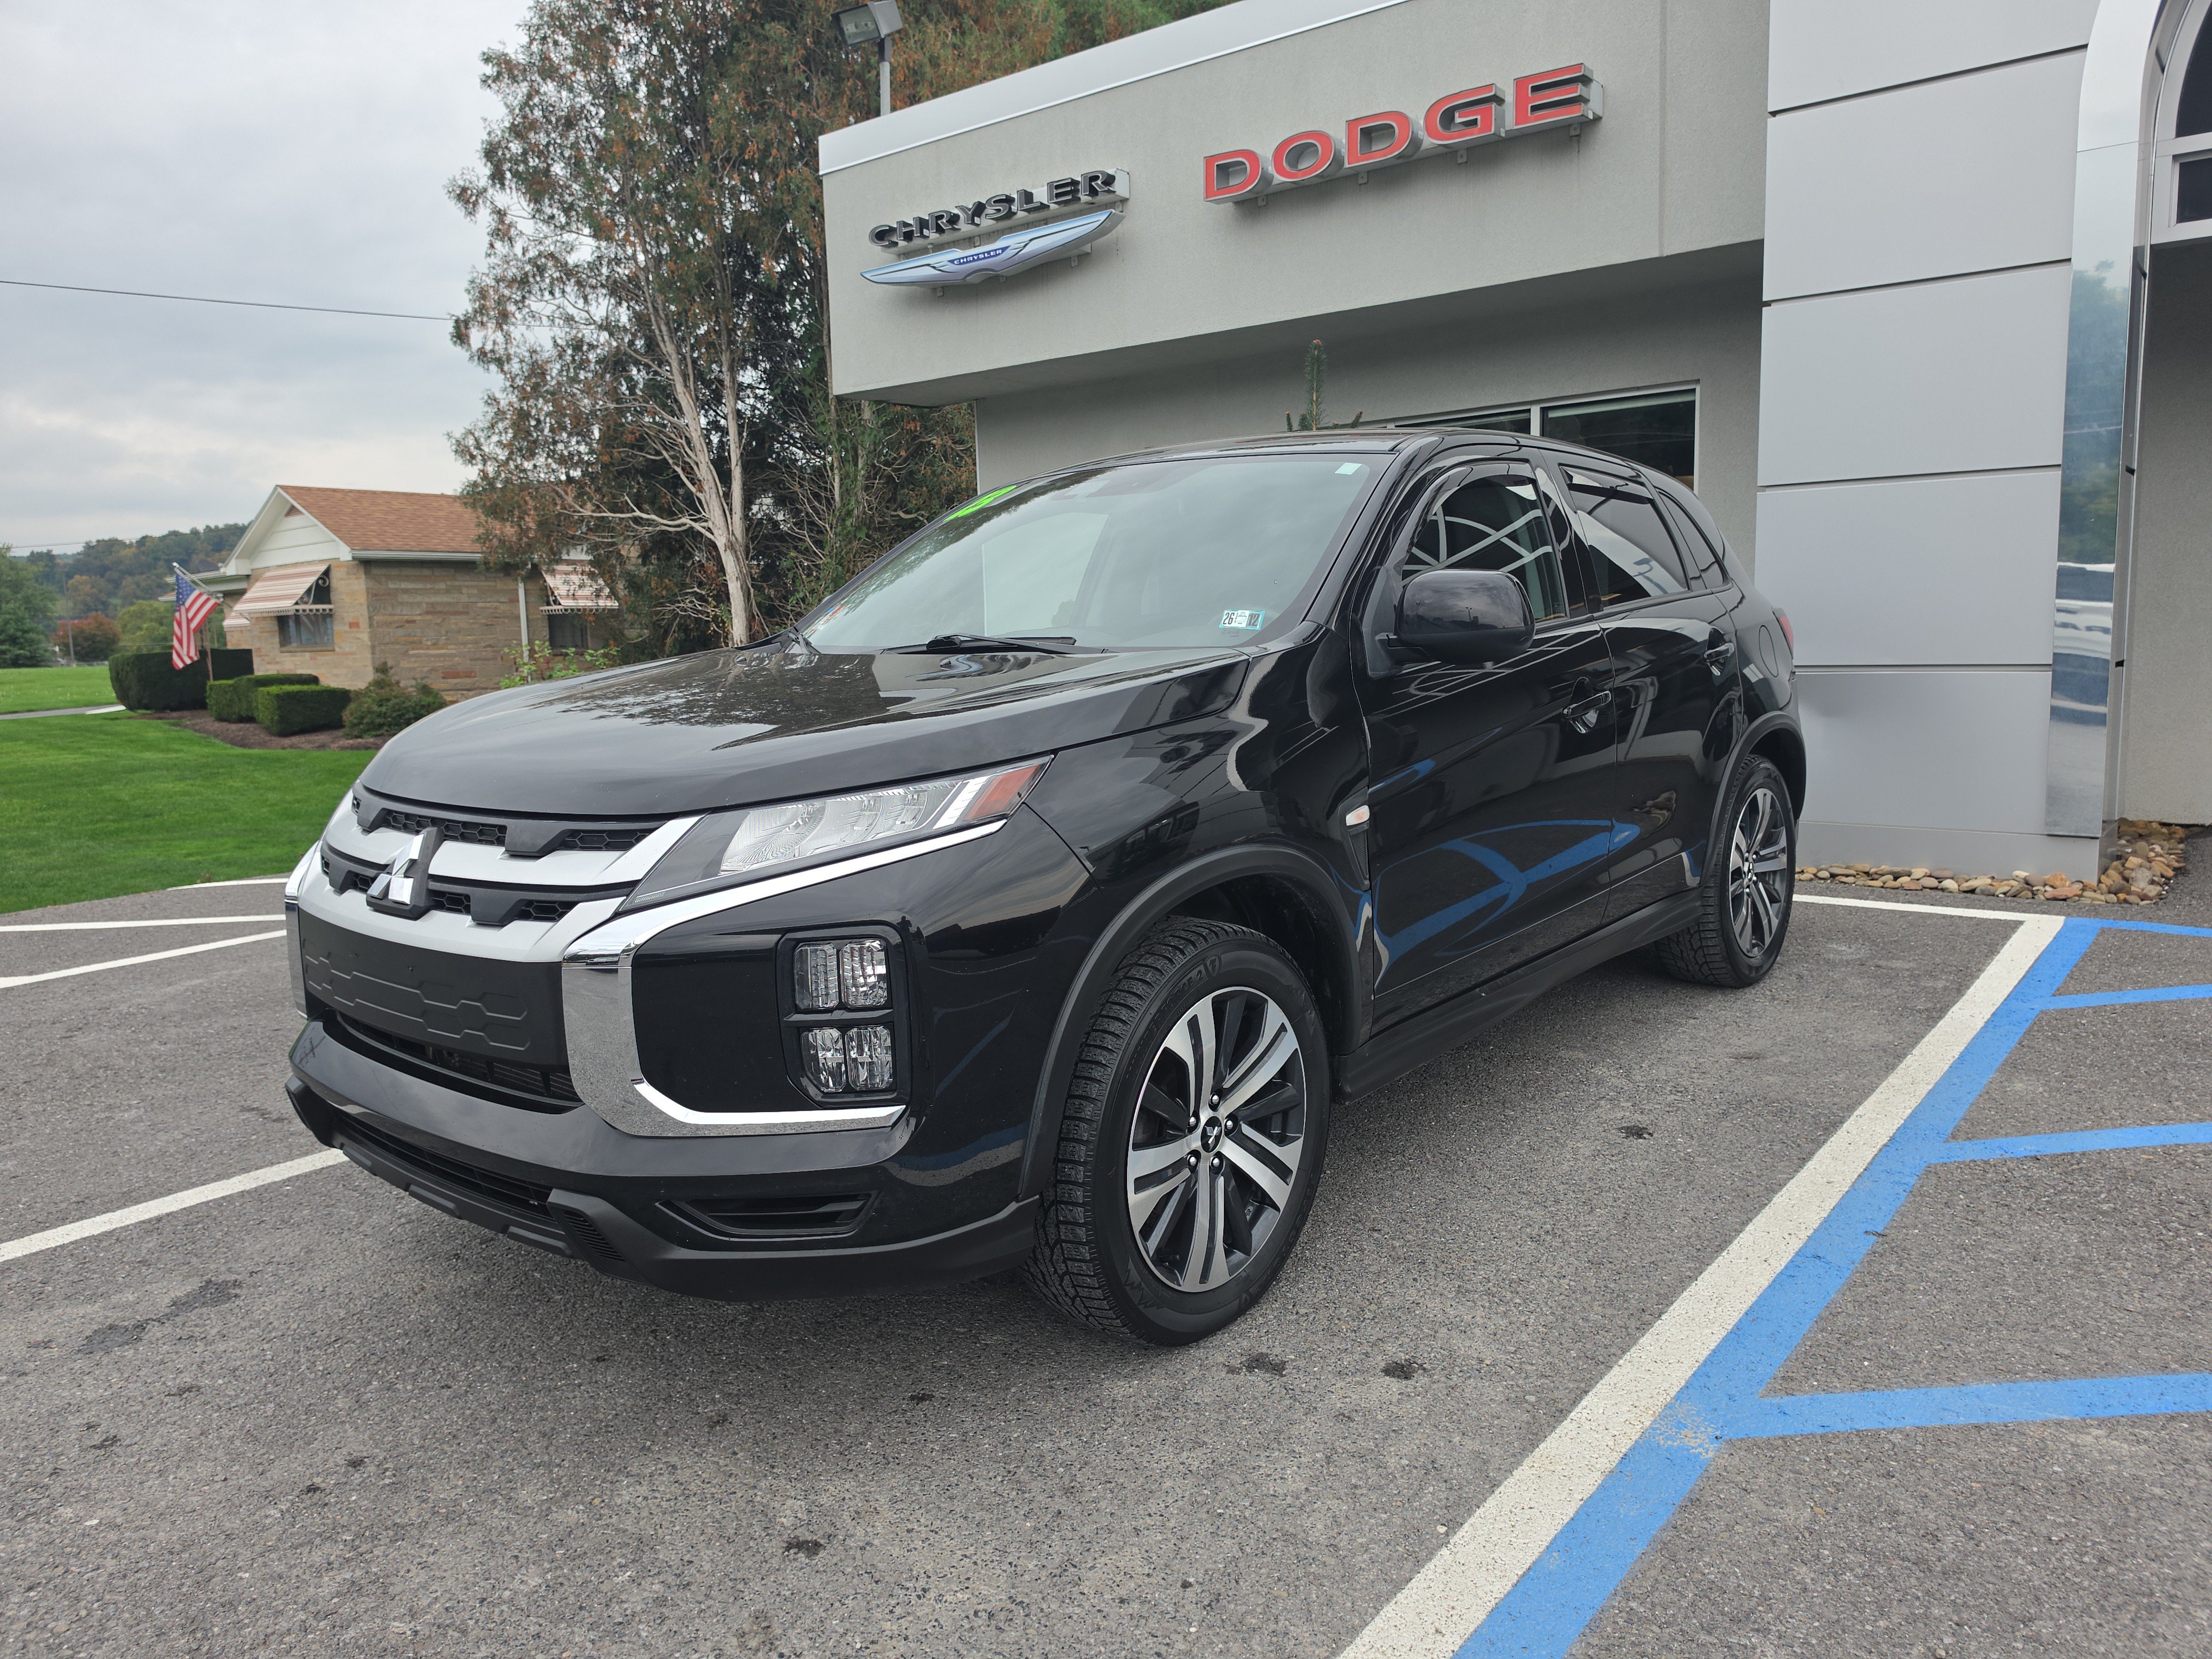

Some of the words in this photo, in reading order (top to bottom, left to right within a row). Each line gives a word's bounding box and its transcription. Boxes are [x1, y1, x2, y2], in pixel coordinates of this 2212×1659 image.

[1204, 63, 1589, 201] DODGE
[869, 170, 1115, 247] CHRYSLER
[954, 249, 1002, 264] CHRYSLER
[1223, 612, 1235, 625] 26
[1248, 613, 1261, 626] 12
